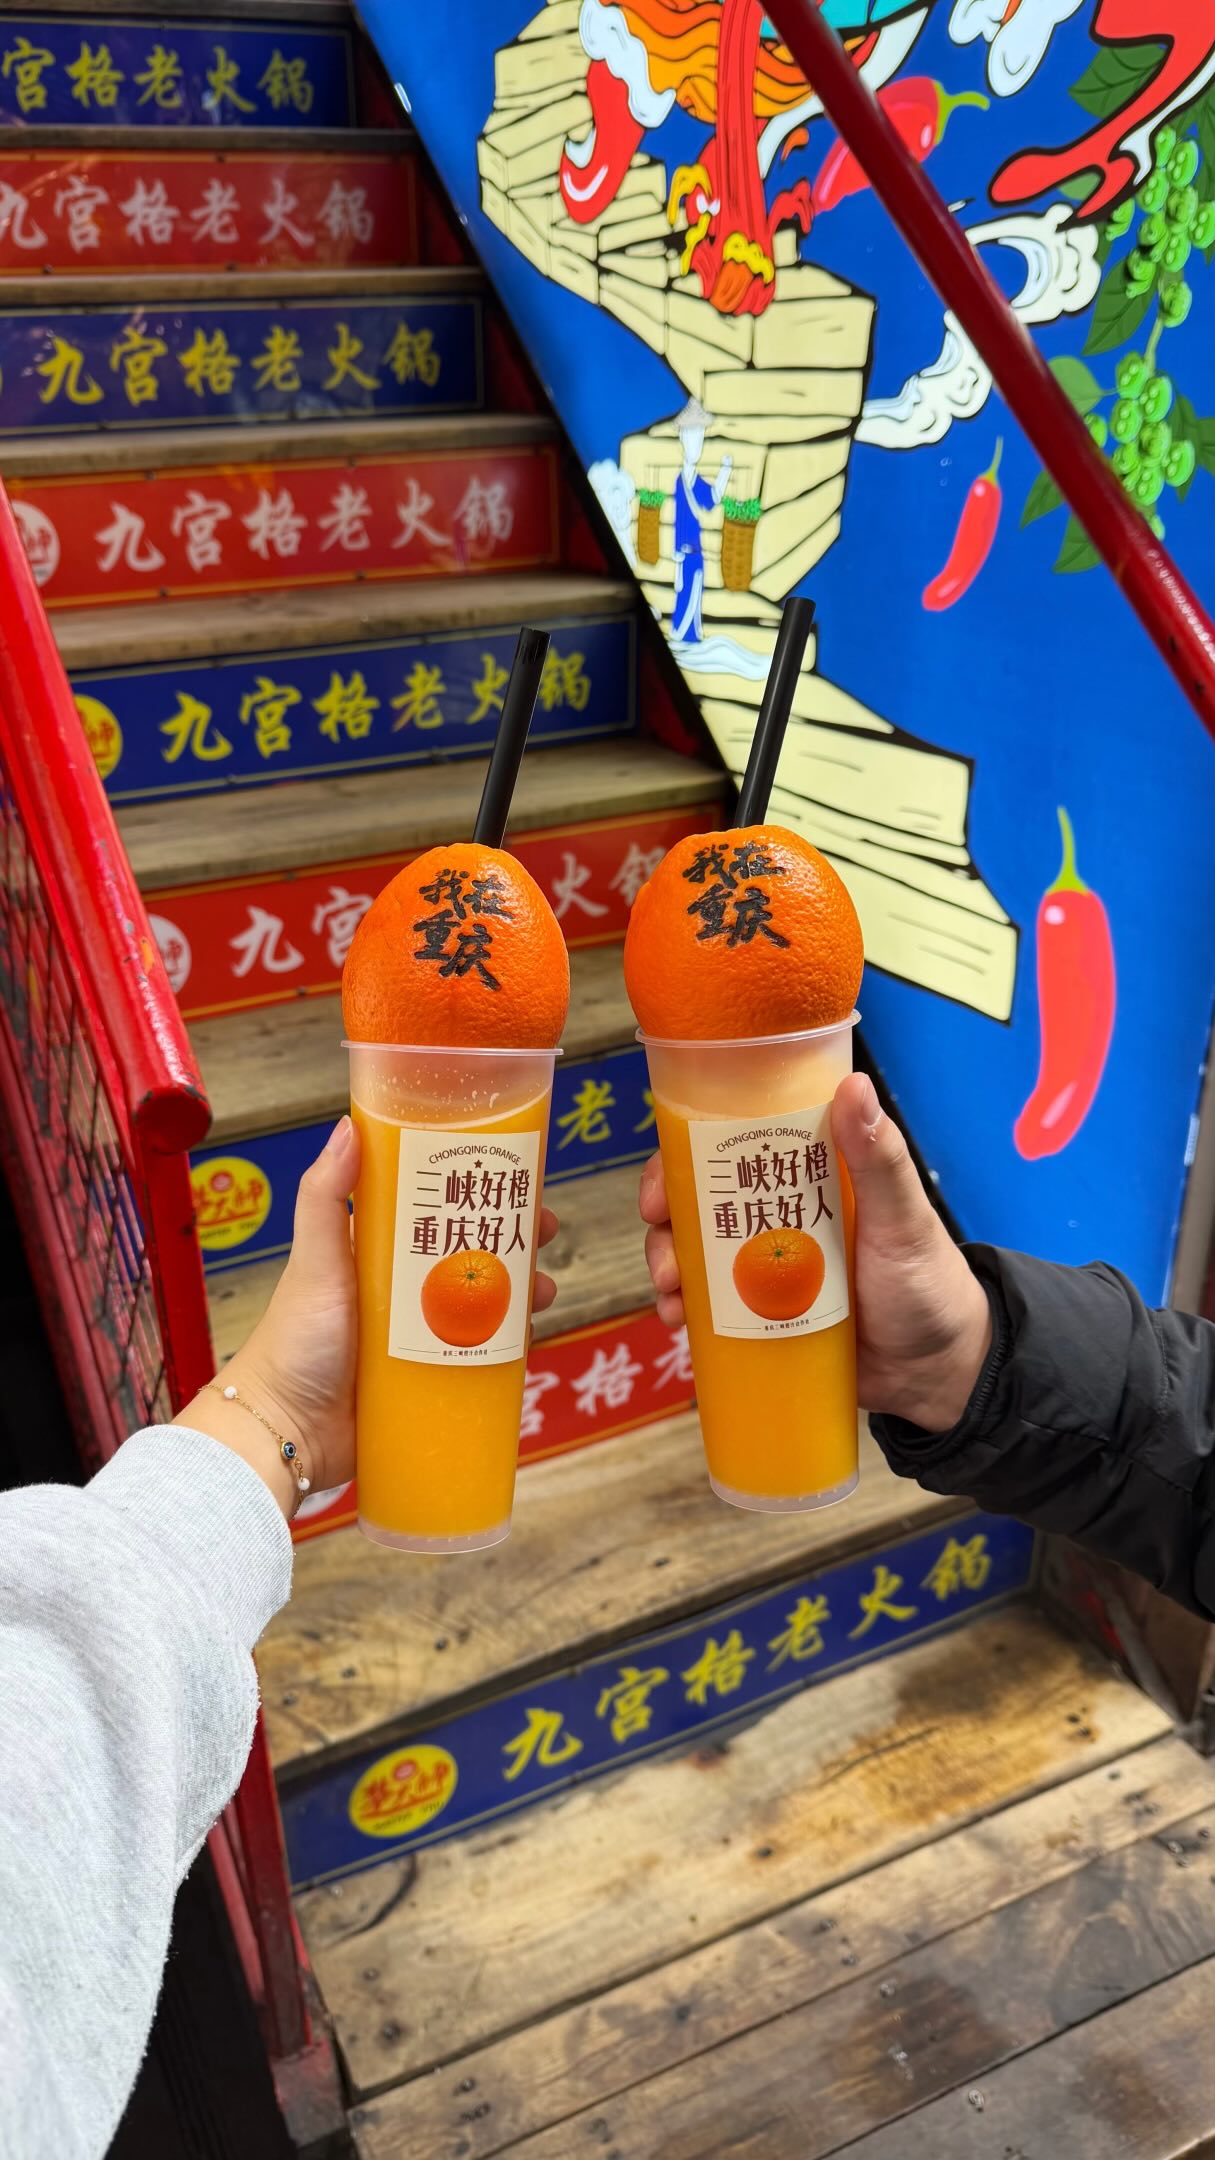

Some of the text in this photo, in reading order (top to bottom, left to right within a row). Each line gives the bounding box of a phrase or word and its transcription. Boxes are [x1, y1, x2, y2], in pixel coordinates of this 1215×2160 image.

[2, 38, 314, 113] 宫格老火锅
[0, 177, 375, 252] 九宫格老火锅
[38, 323, 442, 406] 九宫格老火锅
[96, 476, 514, 573] 九宫格老火锅
[160, 650, 592, 764] 九宫格老火锅
[419, 868, 516, 920] 我在
[682, 841, 787, 889] 我在
[687, 883, 791, 948] 重庆
[413, 909, 502, 992] 重庆
[428, 1145, 522, 1166] CHONGQING ORANGE
[707, 1141, 829, 1194] 三峡好橙
[716, 1127, 813, 1152] CHONGQING ORANGE
[412, 1169, 530, 1211] 三峡好橙
[713, 1186, 833, 1238] 重庆好人
[410, 1213, 525, 1256] 重庆好人
[502, 1533, 993, 1781] 九宫格老火锅
